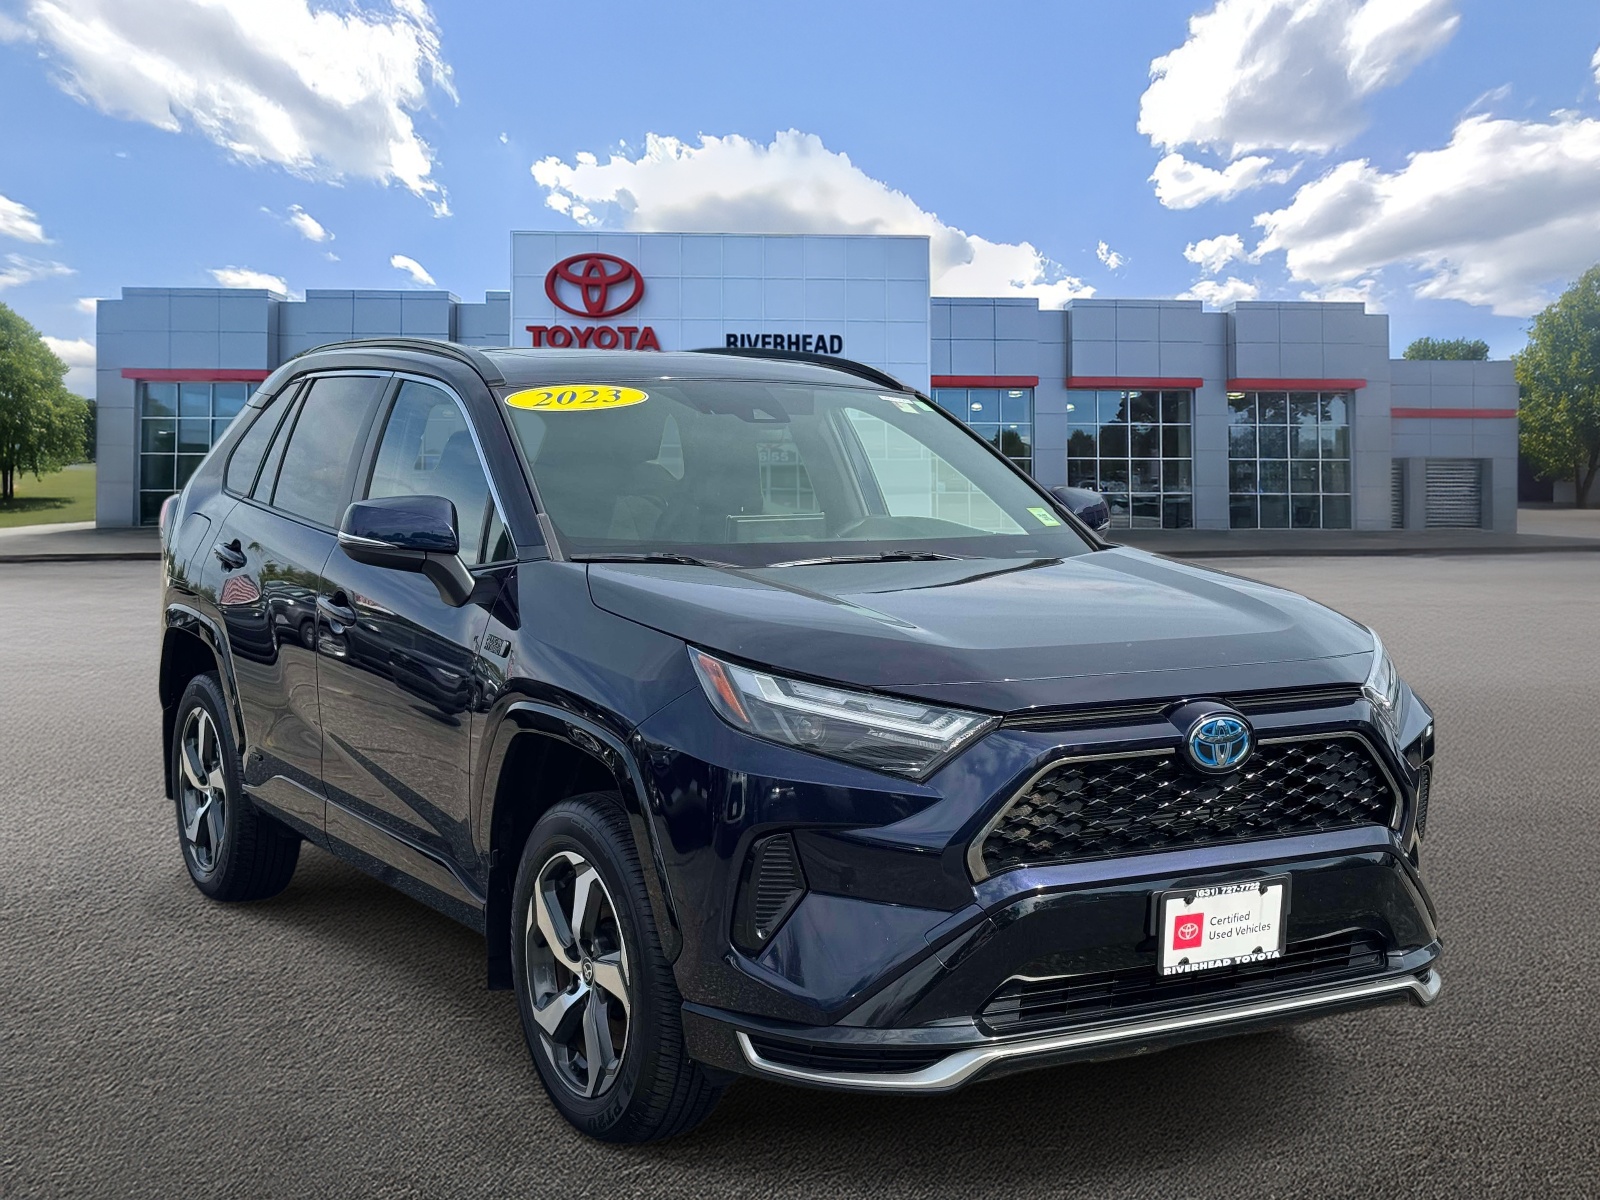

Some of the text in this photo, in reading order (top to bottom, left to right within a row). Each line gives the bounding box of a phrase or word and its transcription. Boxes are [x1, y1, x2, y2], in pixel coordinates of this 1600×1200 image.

[525, 325, 661, 351] TOYOTA
[726, 333, 843, 354] RIVERHEAD
[532, 389, 622, 407] 2023
[1196, 882, 1260, 898] (631) 727-7722
[1209, 911, 1251, 926] Certified
[1208, 922, 1272, 940] Used Vehicles
[1163, 949, 1281, 976] RIVERHEAD TOYOTA
